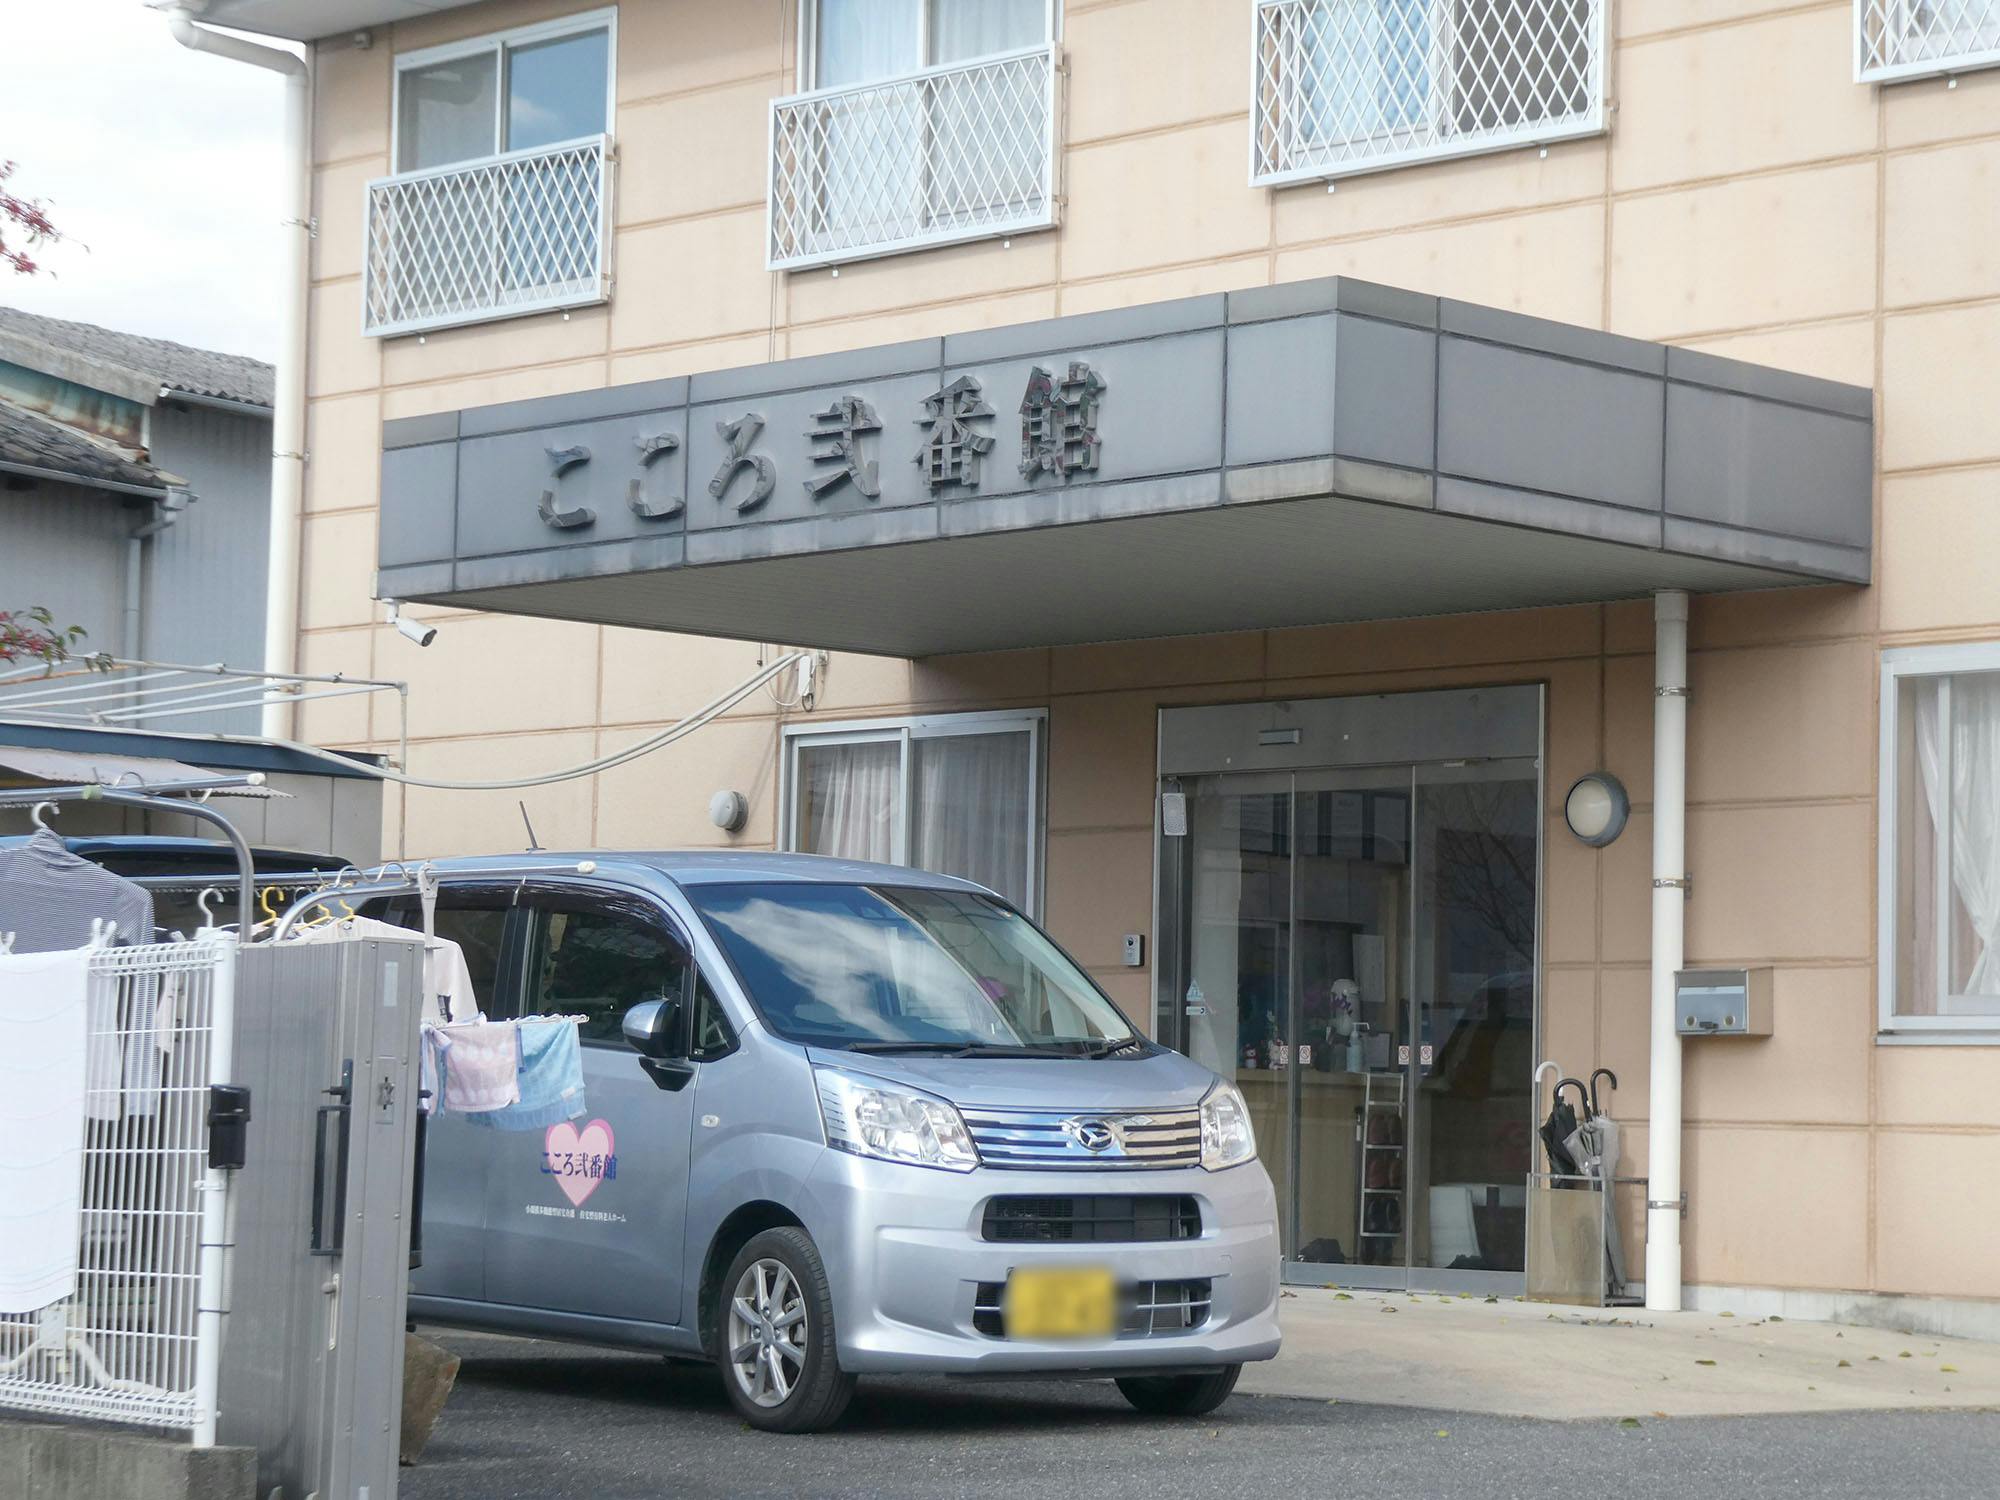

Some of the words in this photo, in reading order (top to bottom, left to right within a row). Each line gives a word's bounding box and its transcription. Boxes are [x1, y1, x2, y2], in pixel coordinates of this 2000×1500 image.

[538, 360, 1107, 530] こころ弐番館
[540, 1151, 618, 1180] こころ弐番館
